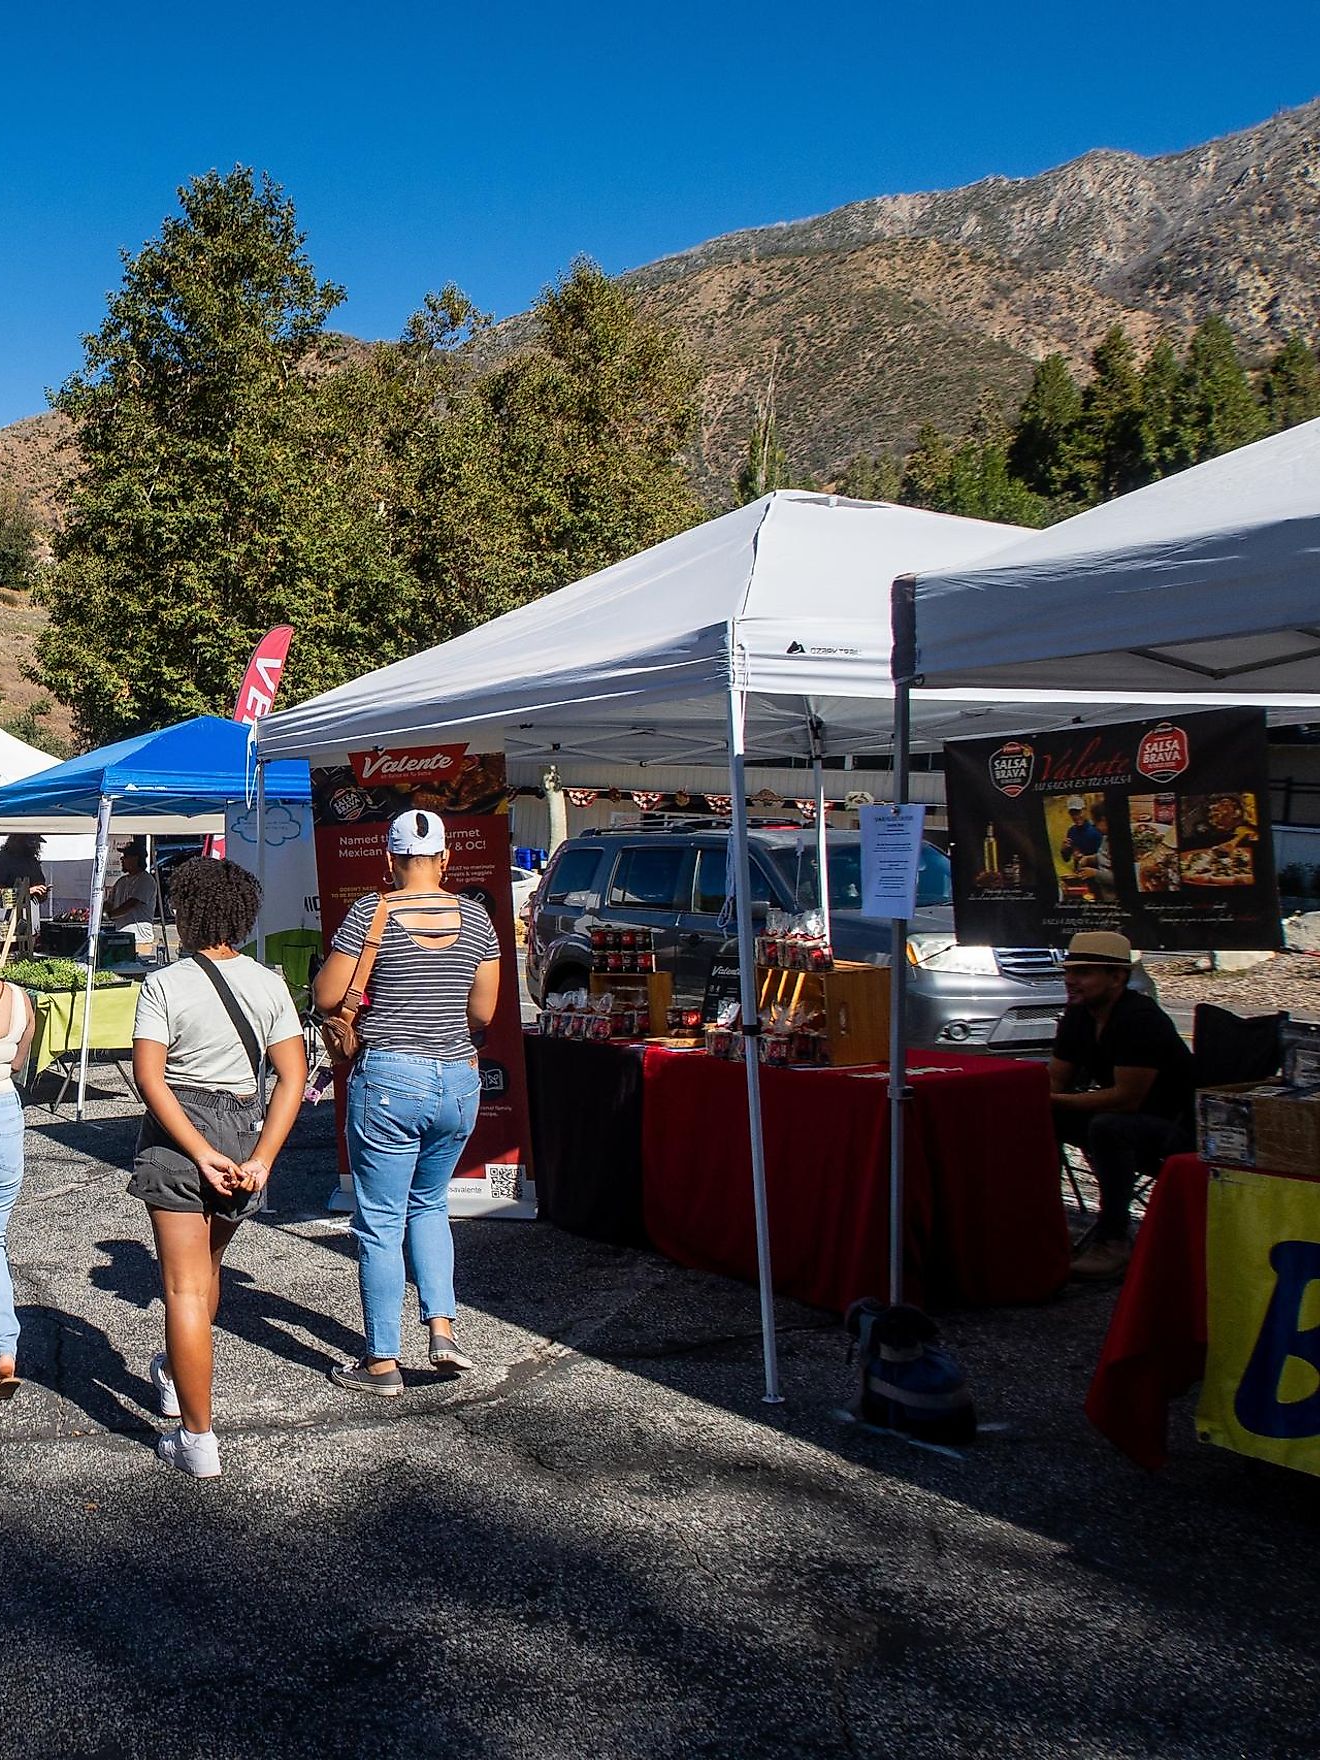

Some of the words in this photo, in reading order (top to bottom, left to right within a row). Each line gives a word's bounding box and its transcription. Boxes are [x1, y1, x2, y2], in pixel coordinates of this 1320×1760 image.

[1143, 740, 1180, 754] SALSA
[993, 758, 1030, 770] SALSA
[1143, 750, 1182, 764] BRAVA
[362, 752, 454, 779] Valente
[994, 768, 1027, 779] BRAVA
[333, 793, 358, 811] SALSA
[339, 834, 379, 846] Named
[338, 846, 383, 858] Mexican
[465, 840, 486, 851] OC!
[711, 965, 741, 977] Valent
